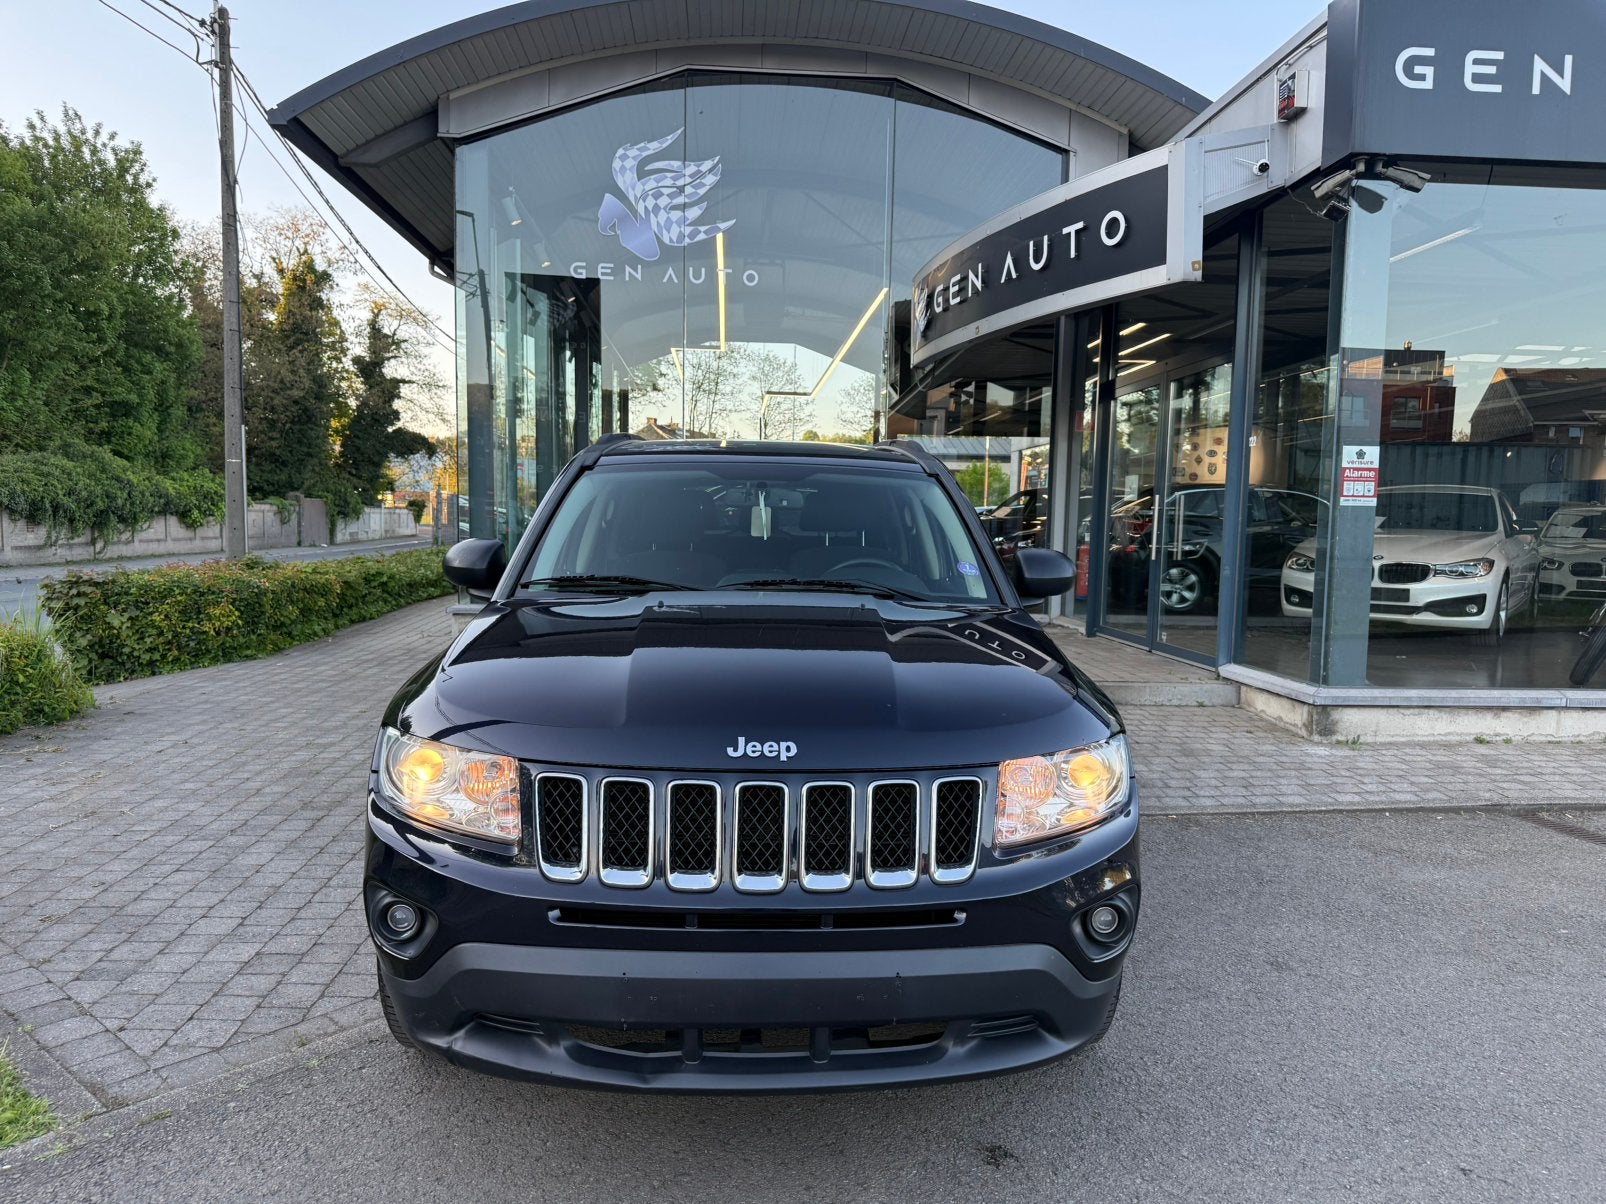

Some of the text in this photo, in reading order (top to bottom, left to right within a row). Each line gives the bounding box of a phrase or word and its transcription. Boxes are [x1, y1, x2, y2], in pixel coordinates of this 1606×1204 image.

[1395, 46, 1573, 96] GEN
[569, 261, 760, 287] GEN AUTO
[933, 209, 1127, 314] GEN AUTO
[1343, 468, 1376, 477] Alarme
[726, 736, 798, 762] Jeep
